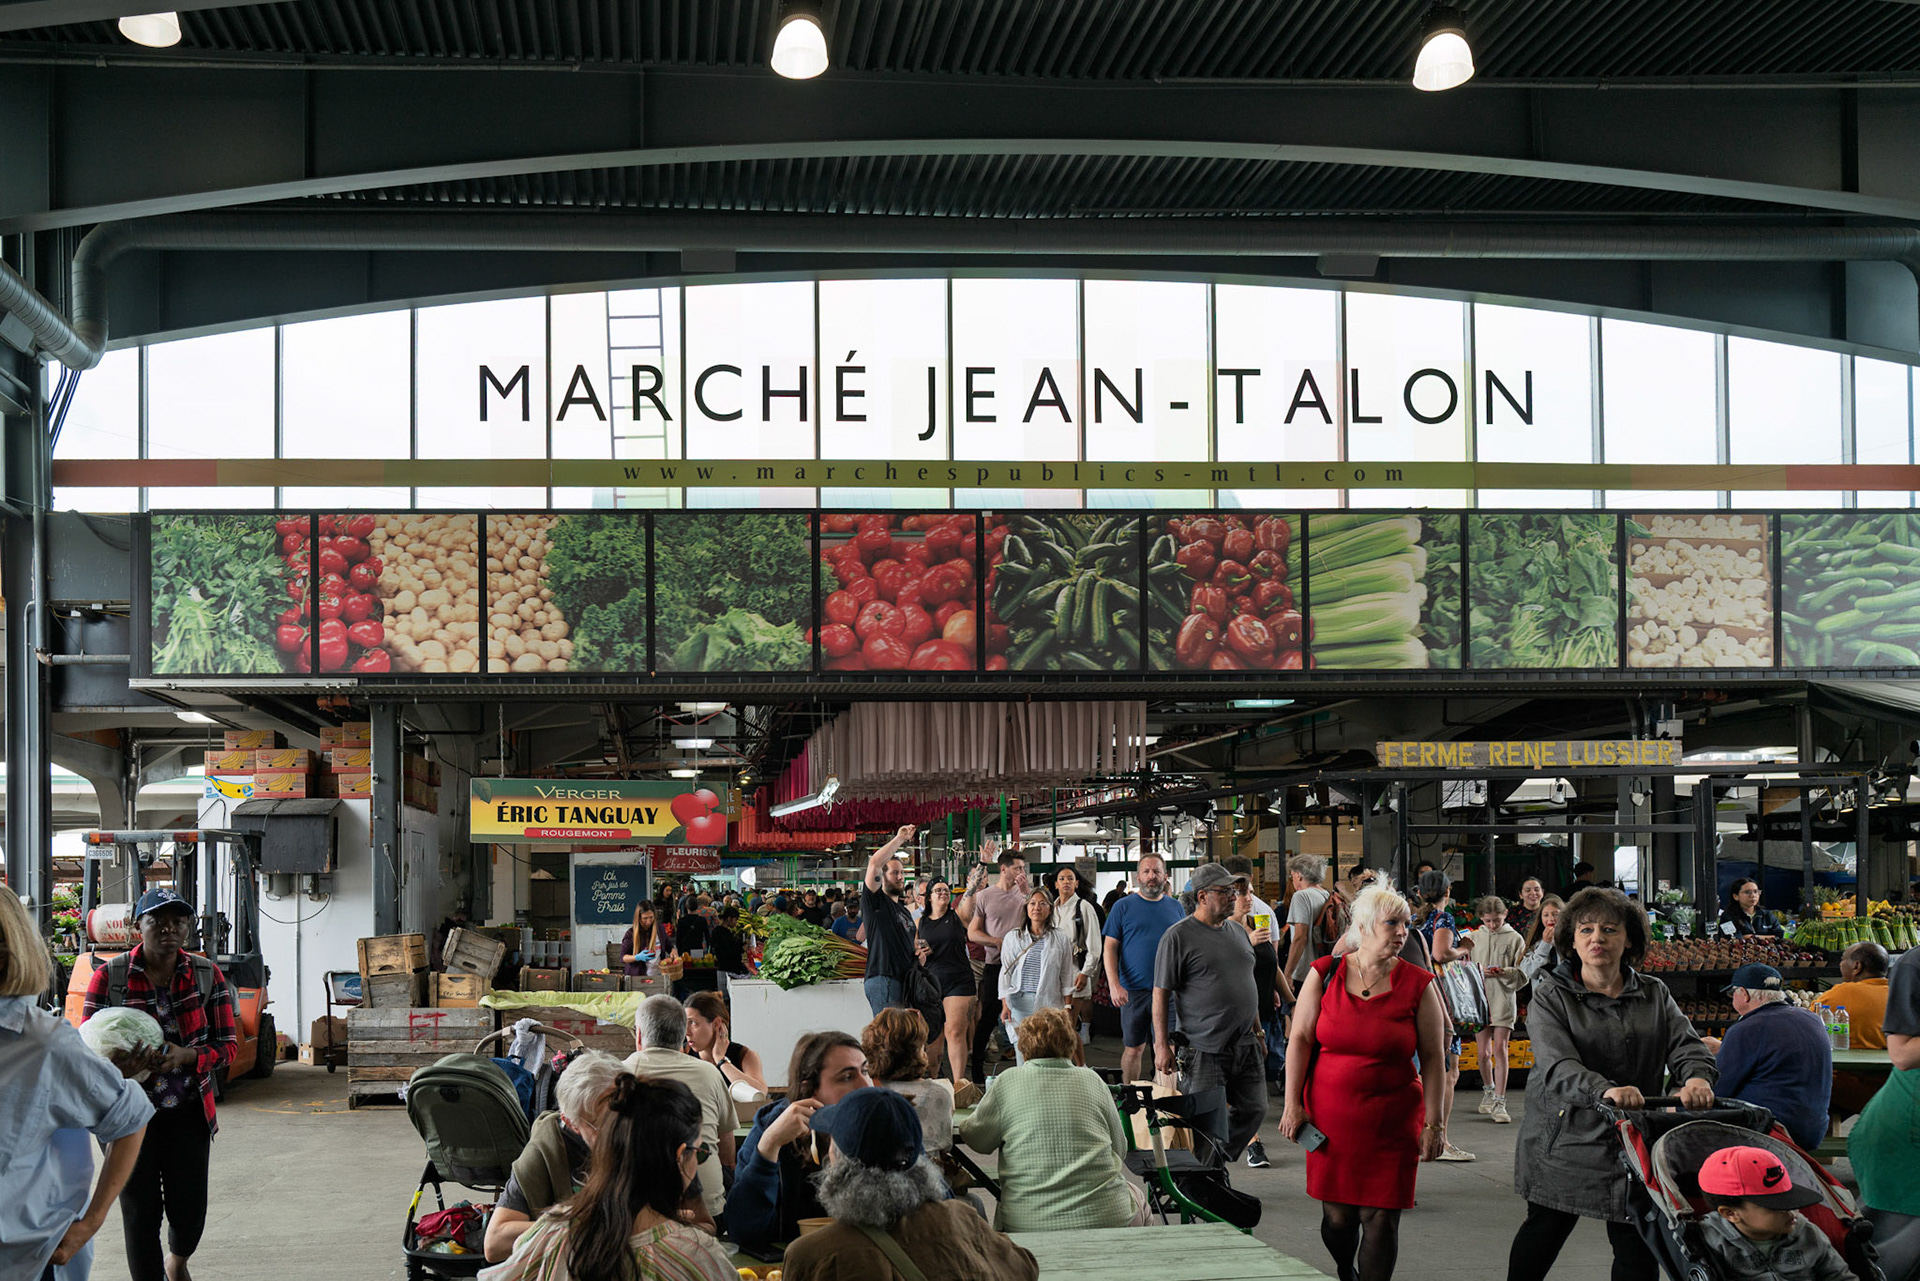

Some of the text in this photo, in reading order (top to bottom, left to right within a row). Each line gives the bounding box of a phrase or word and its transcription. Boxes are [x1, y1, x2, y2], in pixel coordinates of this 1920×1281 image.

[479, 350, 1533, 441] MARCHÉ JEAN-TALON
[623, 463, 1403, 486] www.marchespublics-mtl.com
[1384, 740, 1673, 767] FERME RENE LUSSIER
[534, 785, 622, 800] VERGER
[497, 801, 659, 825] ÉRIC TANGUAY
[541, 829, 614, 838] ROUGEMONT
[666, 847, 718, 857] FLEURISTE
[663, 858, 686, 869] Chez
[620, 880, 629, 888] de
[591, 890, 626, 901] Pomme
[597, 901, 625, 913] Frais
